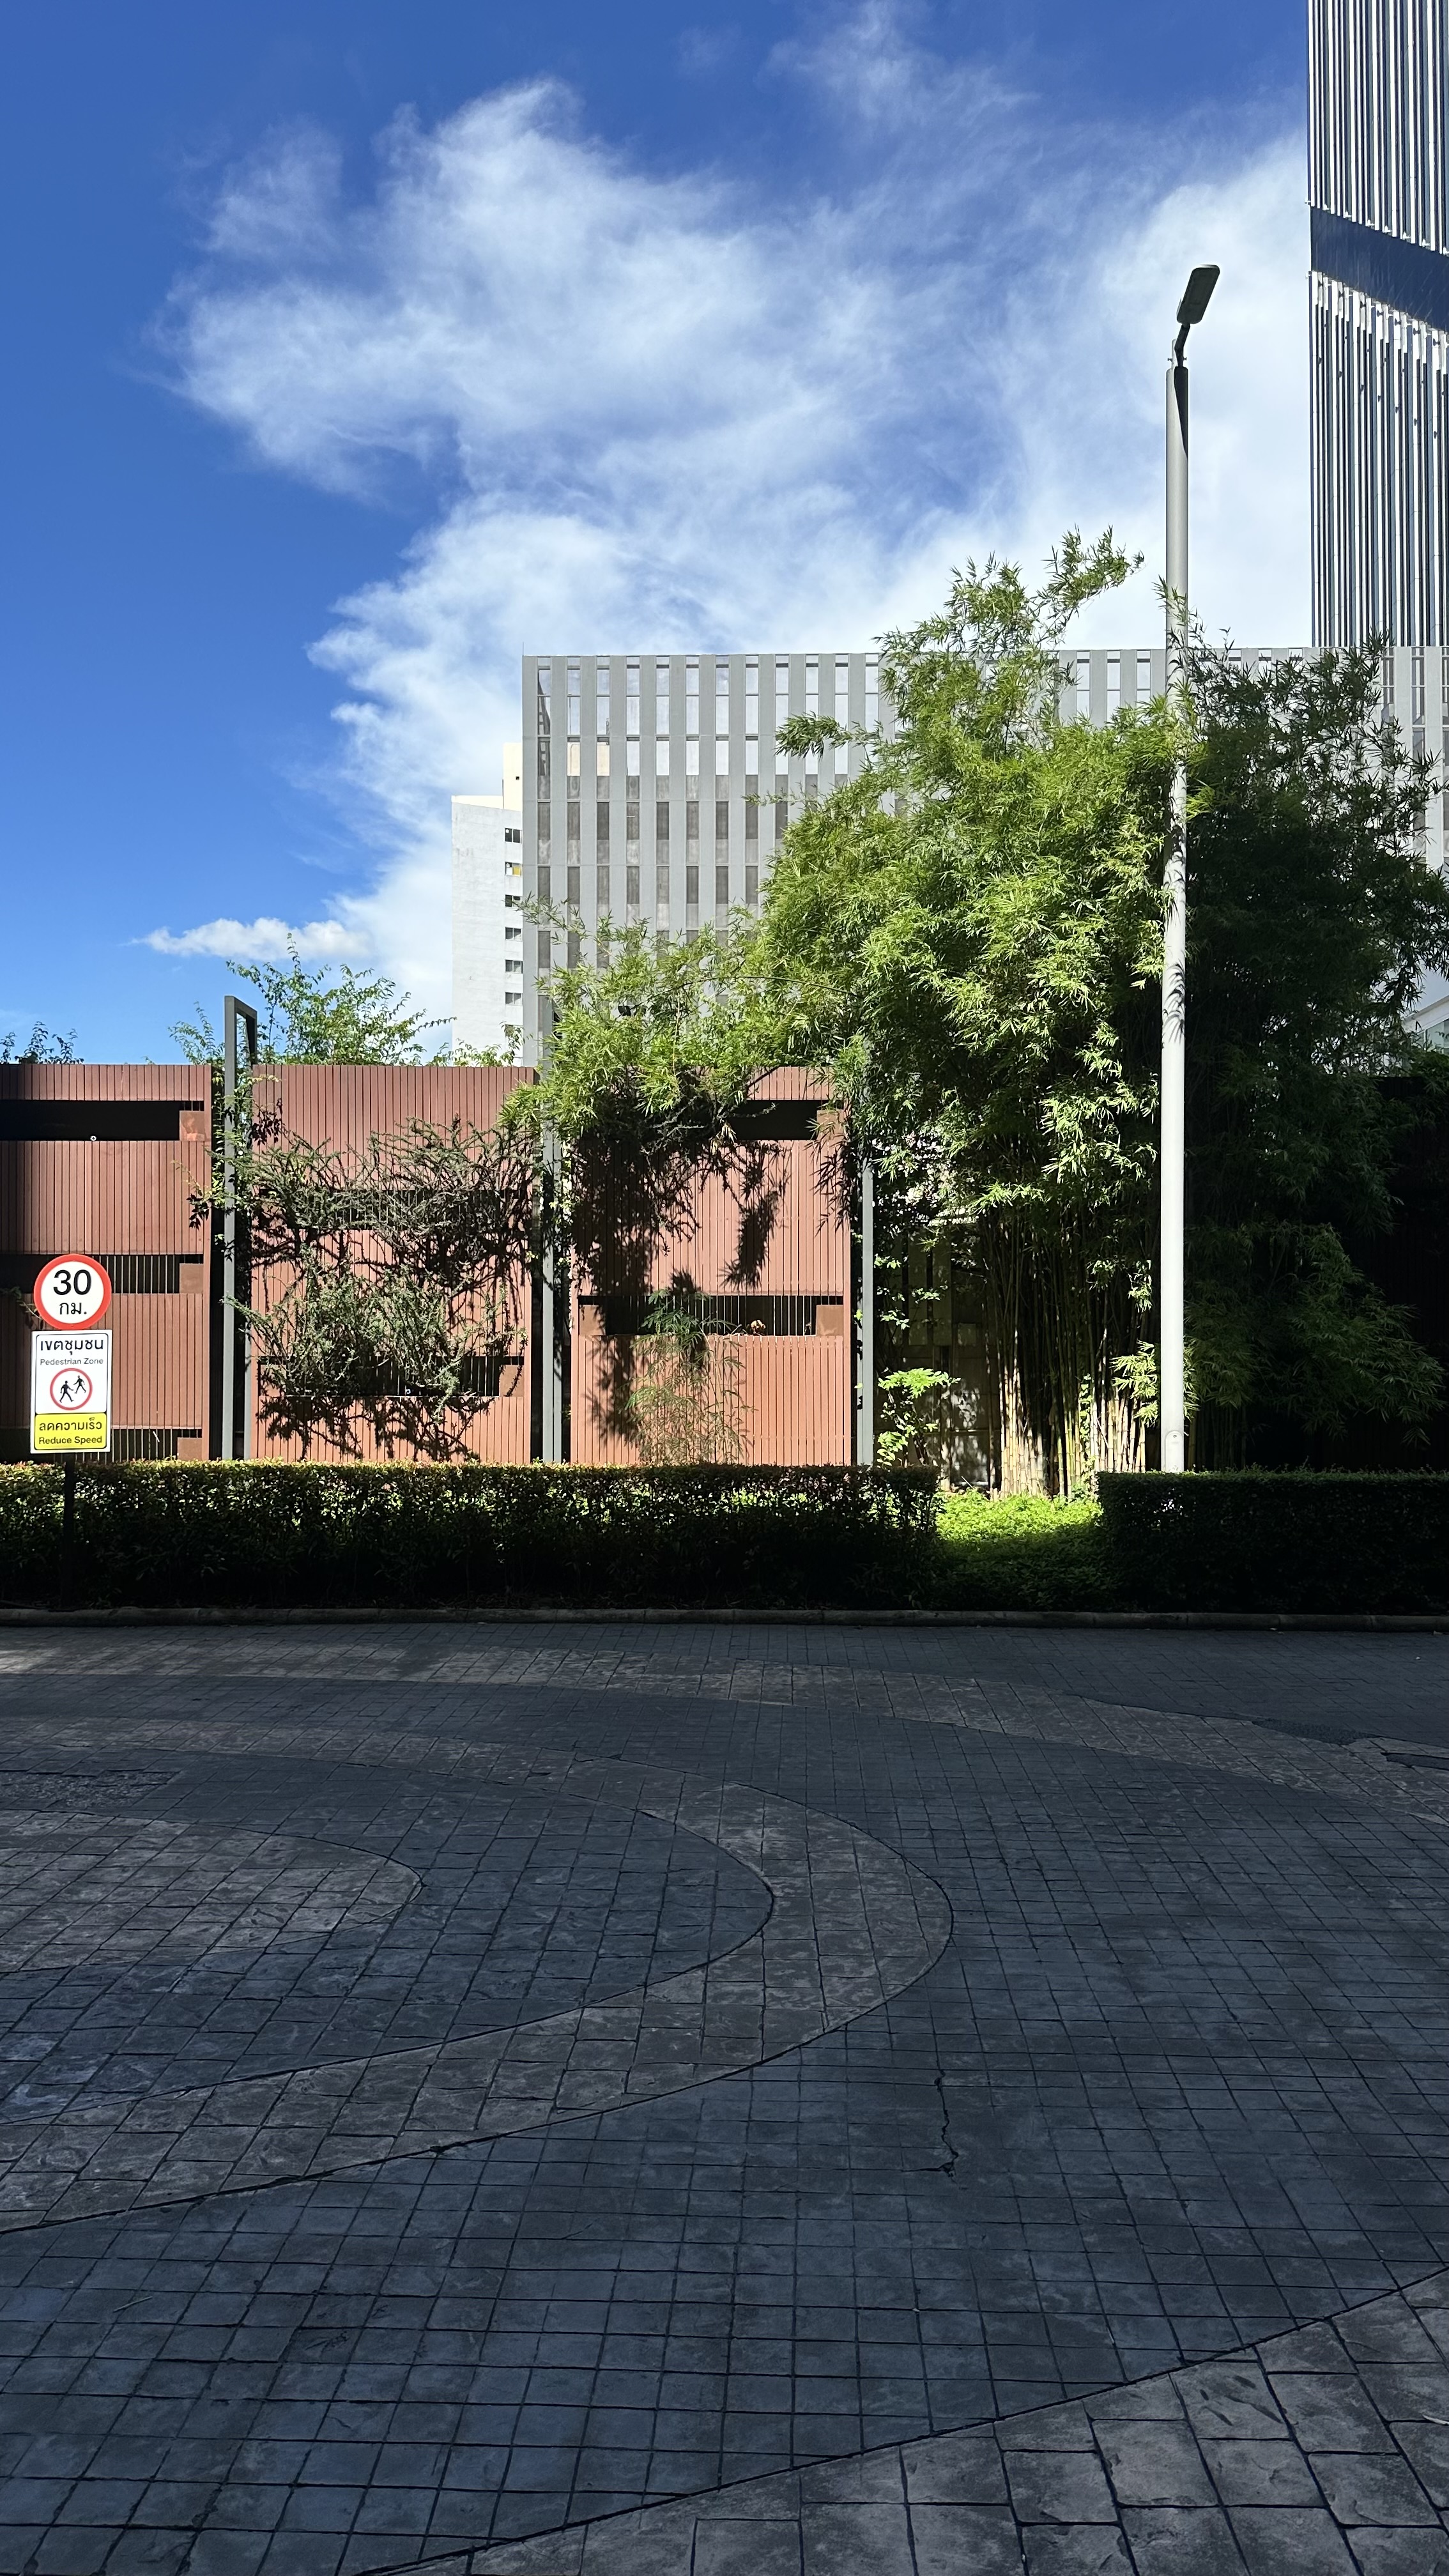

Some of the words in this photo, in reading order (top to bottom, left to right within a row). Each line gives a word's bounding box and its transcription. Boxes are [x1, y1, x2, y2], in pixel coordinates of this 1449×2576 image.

[53, 1269, 92, 1296] 30
[59, 1302, 87, 1315] กม.
[40, 1339, 103, 1355] เขตชุมชน
[39, 1417, 102, 1431] ลดความเร็ว
[74, 1436, 102, 1445] Speed
